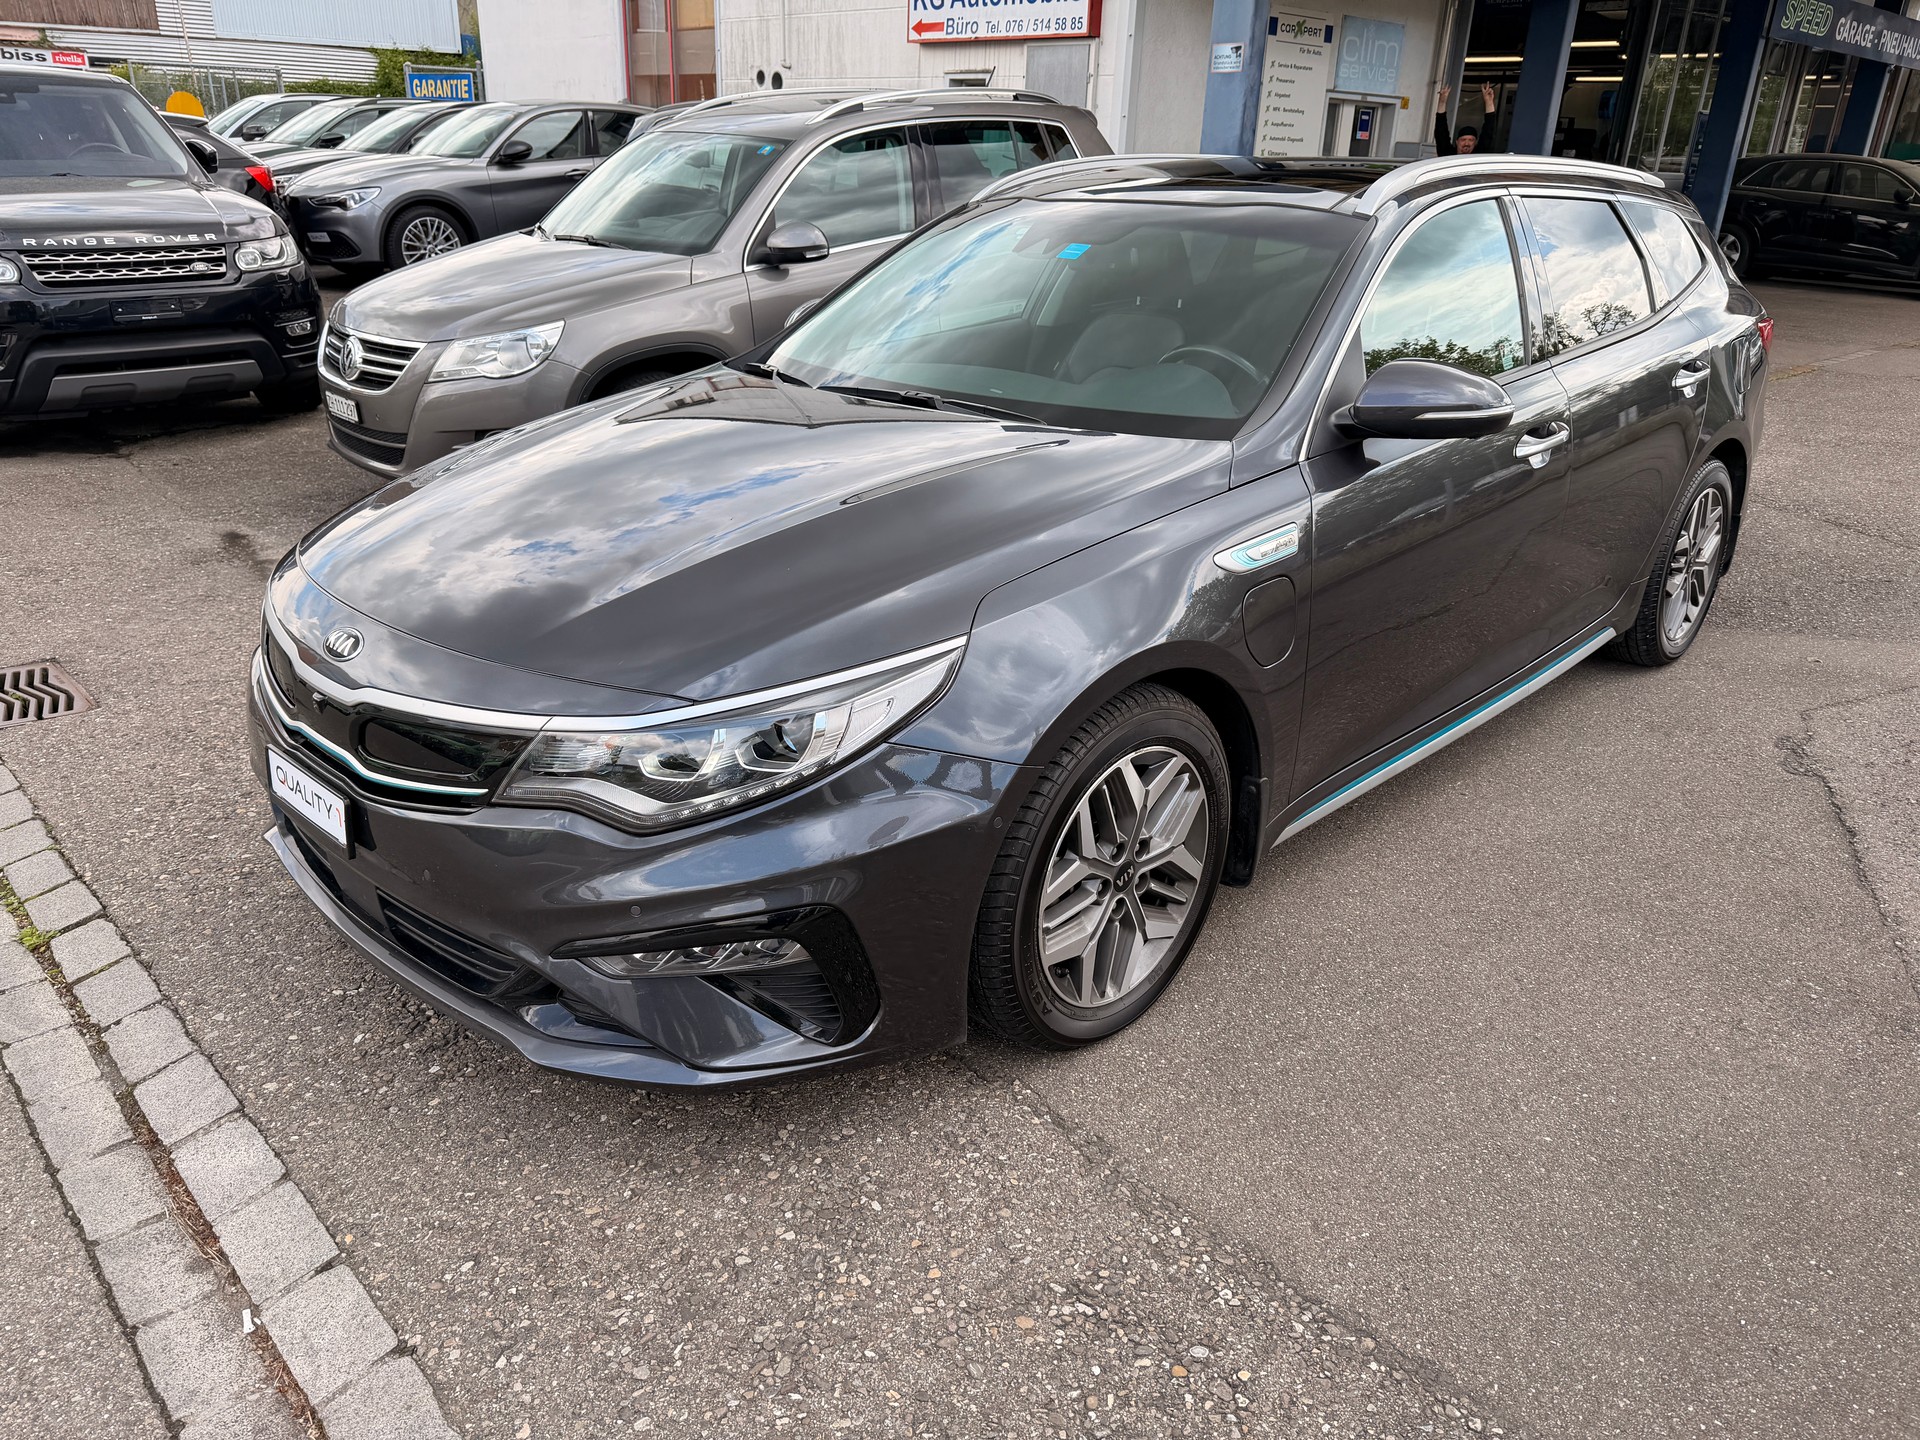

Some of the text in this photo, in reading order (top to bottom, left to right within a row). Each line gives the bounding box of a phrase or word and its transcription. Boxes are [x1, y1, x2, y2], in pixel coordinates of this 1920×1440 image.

[950, 0, 1081, 9] Automb
[945, 17, 979, 36] Büro
[985, 21, 1002, 34] Tel.
[1005, 20, 1024, 33] 076
[1033, 18, 1051, 32] 514
[1054, 17, 1067, 31] 58
[1070, 16, 1084, 30] 85
[1781, 0, 1834, 37] SPEED
[1835, 17, 1876, 48] GARAGE
[0, 48, 48, 62] biss
[1343, 25, 1399, 67] clim
[55, 54, 82, 64] rivella
[1339, 63, 1396, 82] service
[412, 78, 469, 99] GARANTIE
[22, 233, 218, 246] RANGE ROVER
[326, 630, 356, 656] KIA
[275, 765, 333, 820] QUALITY
[1115, 865, 1135, 887] KIA
